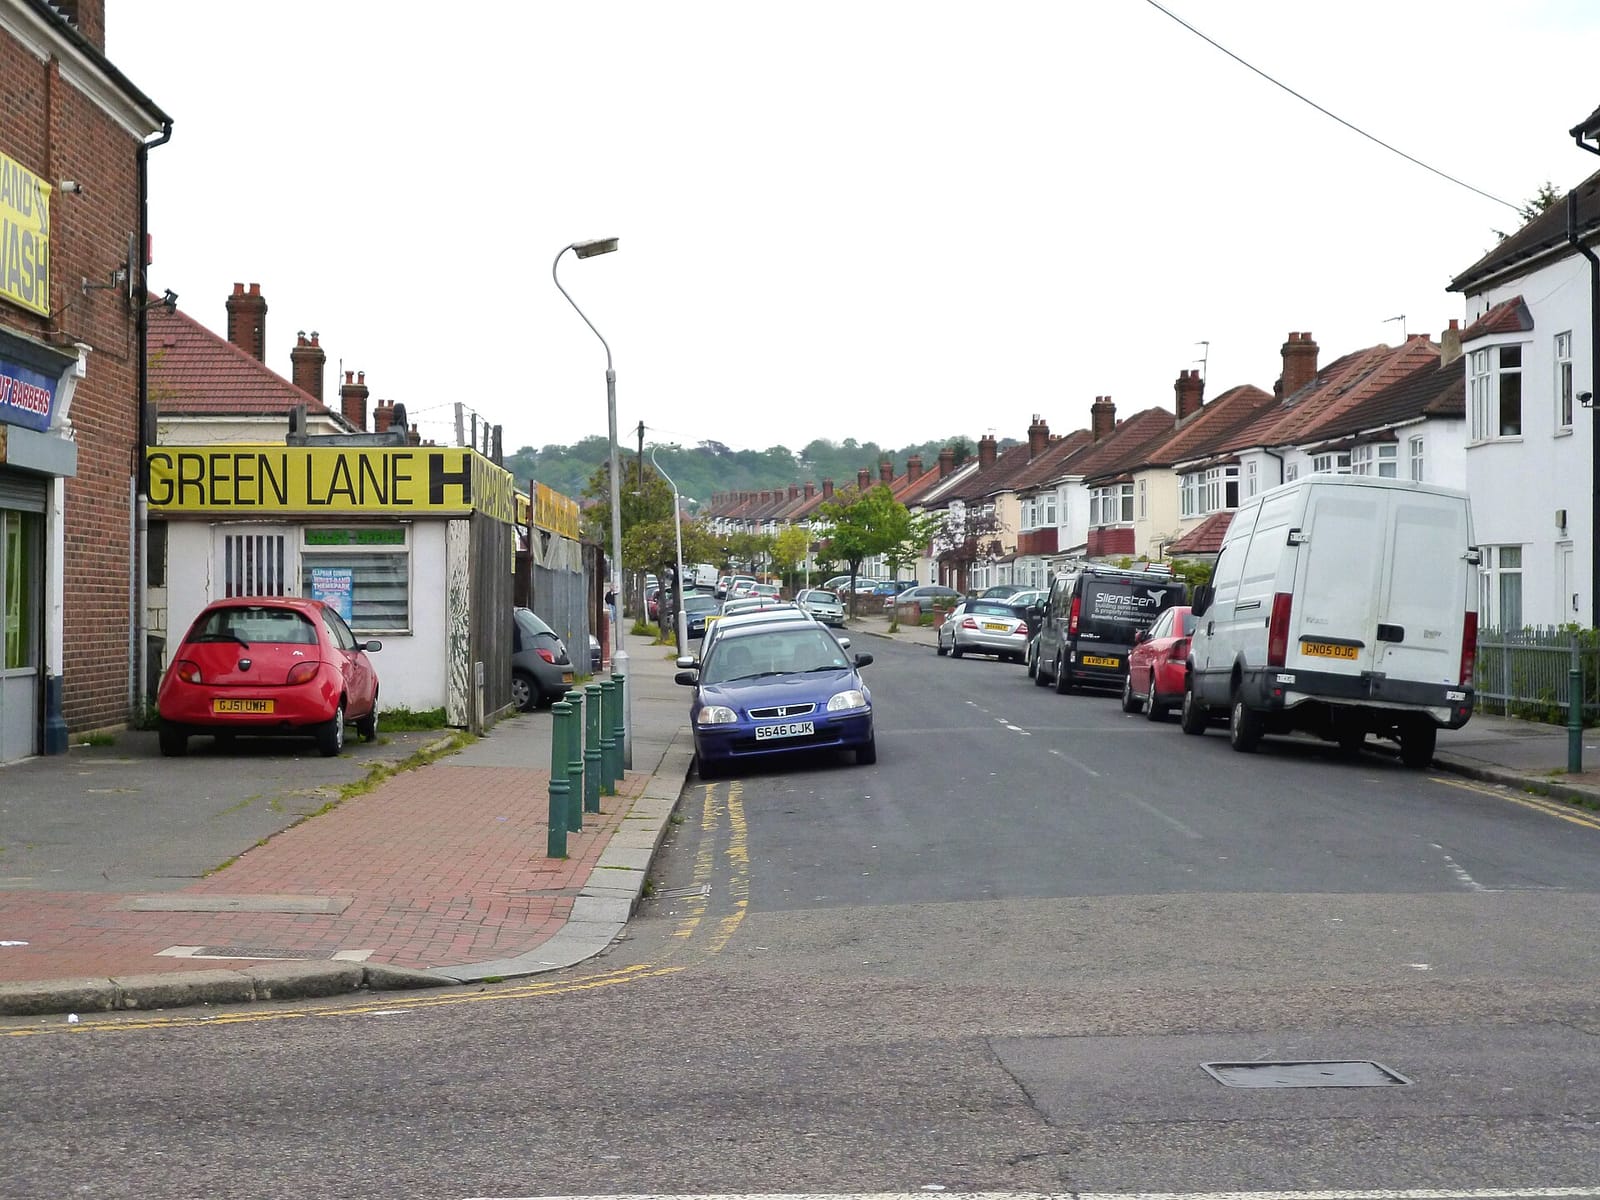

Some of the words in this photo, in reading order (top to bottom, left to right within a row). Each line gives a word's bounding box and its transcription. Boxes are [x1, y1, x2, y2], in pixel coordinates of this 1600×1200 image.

[0, 156, 32, 218] AND
[11, 378, 51, 416] BARBERS
[147, 453, 288, 505] GREEN
[306, 453, 414, 505] LANE
[1306, 643, 1333, 656] GN05
[219, 700, 243, 711] GJ51
[757, 725, 787, 738] S646
[789, 722, 813, 734] CJK
